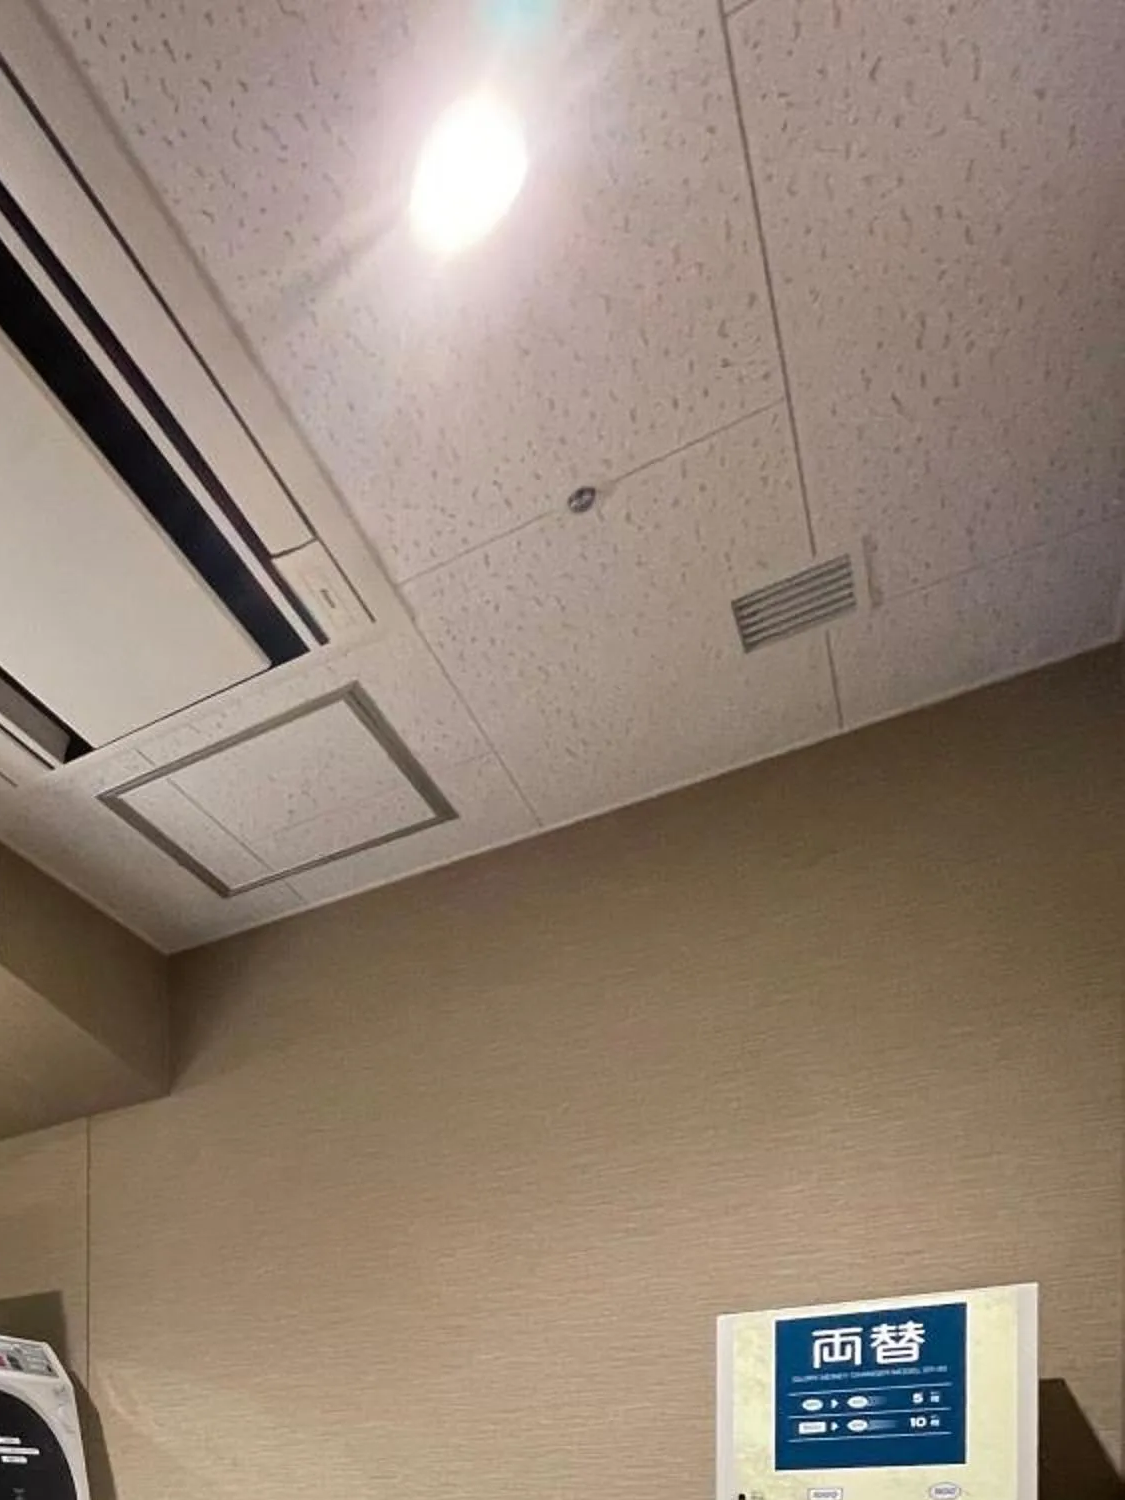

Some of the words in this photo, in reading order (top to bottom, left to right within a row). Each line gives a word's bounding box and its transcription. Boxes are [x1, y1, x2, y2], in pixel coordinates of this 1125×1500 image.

[811, 1320, 926, 1368] 両替
[912, 1392, 924, 1404] 5
[910, 1416, 926, 1428] 10
